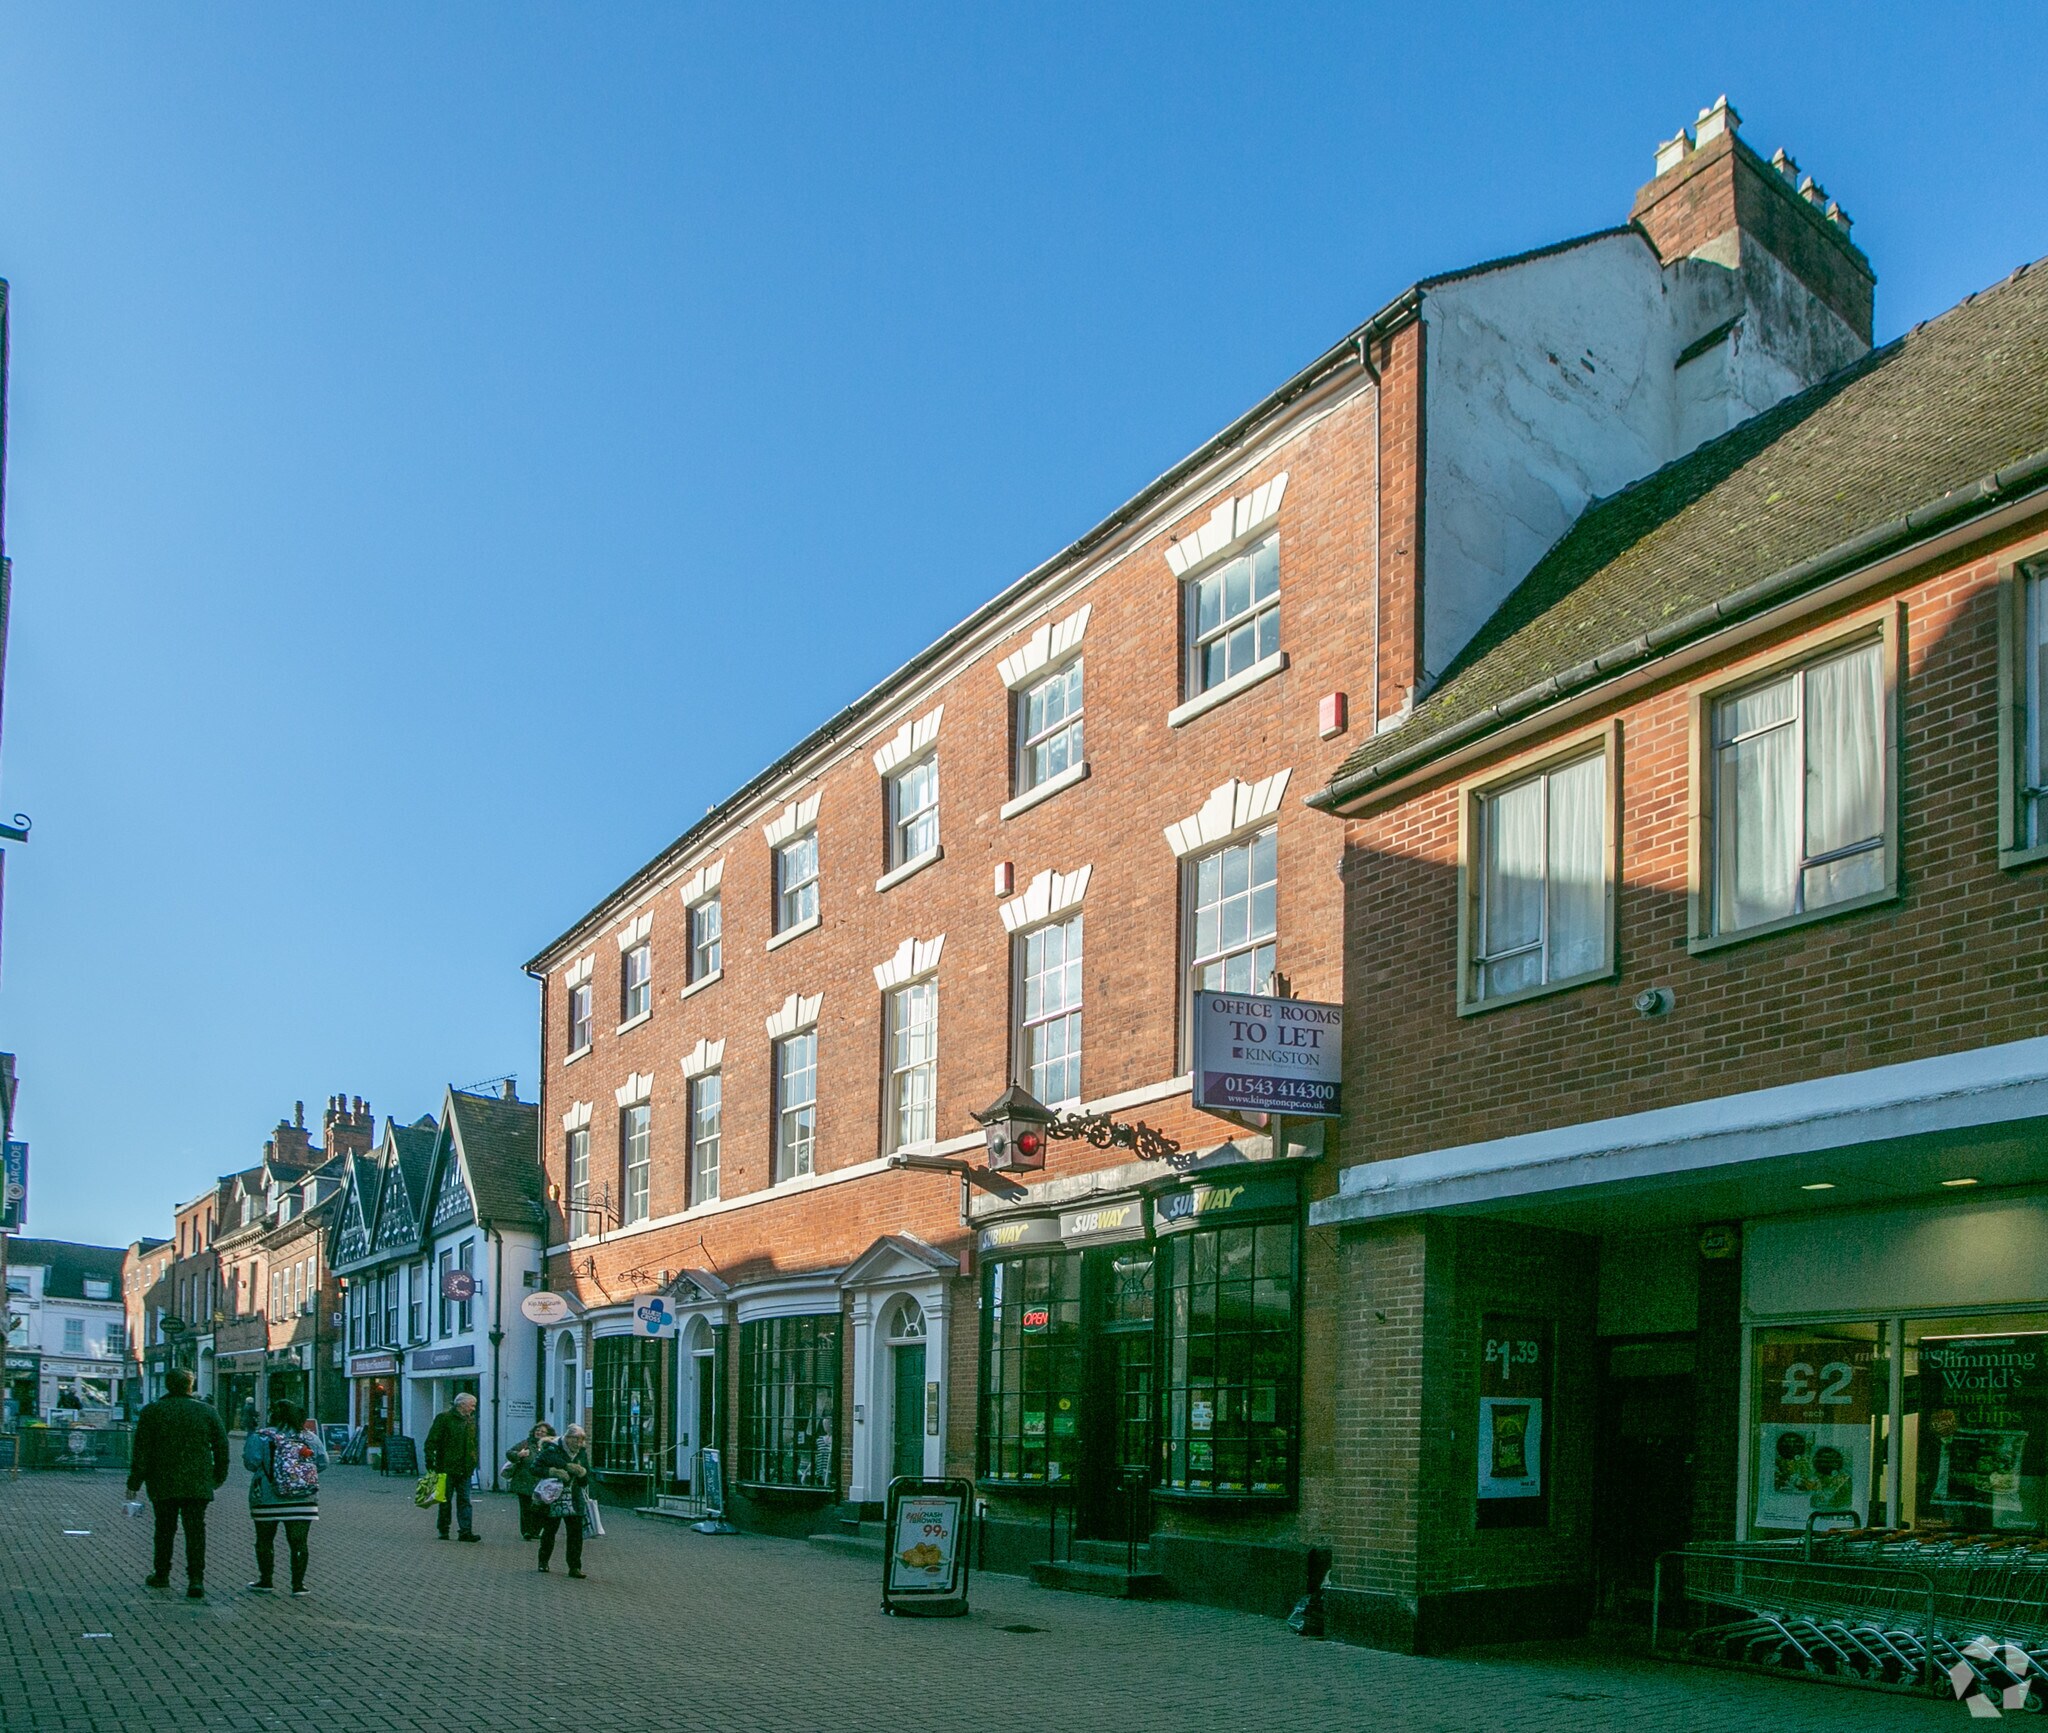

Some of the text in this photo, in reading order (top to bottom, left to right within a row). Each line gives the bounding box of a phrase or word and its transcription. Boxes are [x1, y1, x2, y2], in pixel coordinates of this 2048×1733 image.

[1212, 999, 1341, 1025] OFFICE ROOMS
[1229, 1021, 1324, 1048] TO LET
[1246, 1048, 1320, 1066] KINGSTON
[1225, 1076, 1334, 1100] 01543 414300
[1228, 1094, 1325, 1110] www.kingstoncpc.co.uk
[11, 1144, 21, 1183] ARCADE
[1169, 1185, 1245, 1217] SUBWAY
[1071, 1206, 1130, 1234] SUBWAY
[982, 1223, 1029, 1249] SUBWAY
[640, 1313, 661, 1323] CROSS
[1024, 1312, 1049, 1326] OPEN
[5, 1360, 34, 1368] LOCAL
[1485, 1338, 1539, 1380] £1.39
[1930, 1349, 2036, 1370] Slimming
[1780, 1361, 1853, 1405] £2
[1941, 1368, 2022, 1389] World's
[1944, 1389, 2008, 1407] chunky
[1967, 1405, 2022, 1428] chips
[923, 1524, 948, 1539] 99p
